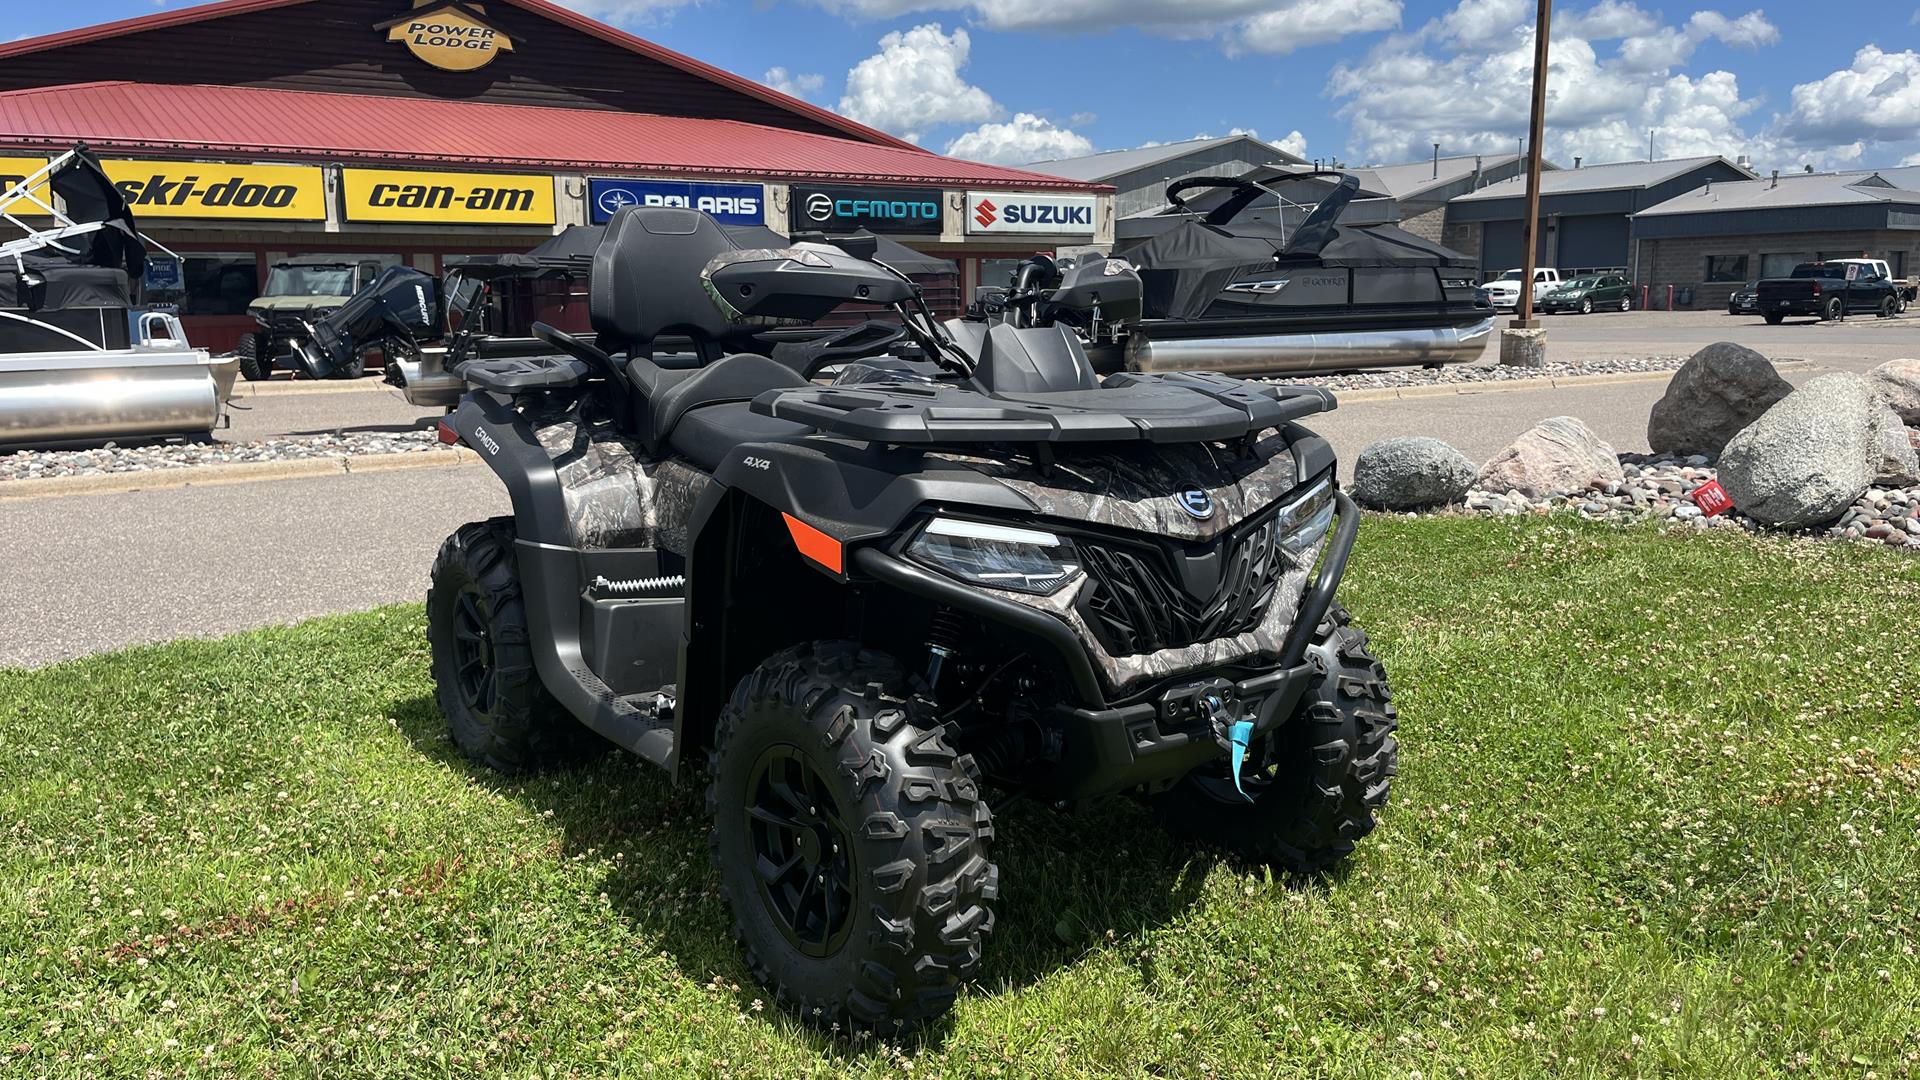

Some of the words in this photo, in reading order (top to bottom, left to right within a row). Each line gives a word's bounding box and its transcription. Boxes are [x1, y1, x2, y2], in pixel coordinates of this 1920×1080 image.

[408, 23, 496, 39] POWER
[414, 34, 493, 50] LODGE
[115, 175, 298, 208] ski-doo
[368, 184, 535, 211] can-am
[835, 199, 938, 219] CFMOTO
[1003, 205, 1092, 225] SUZUKI
[415, 284, 430, 326] MERCURY
[474, 426, 500, 456] CFMOTO
